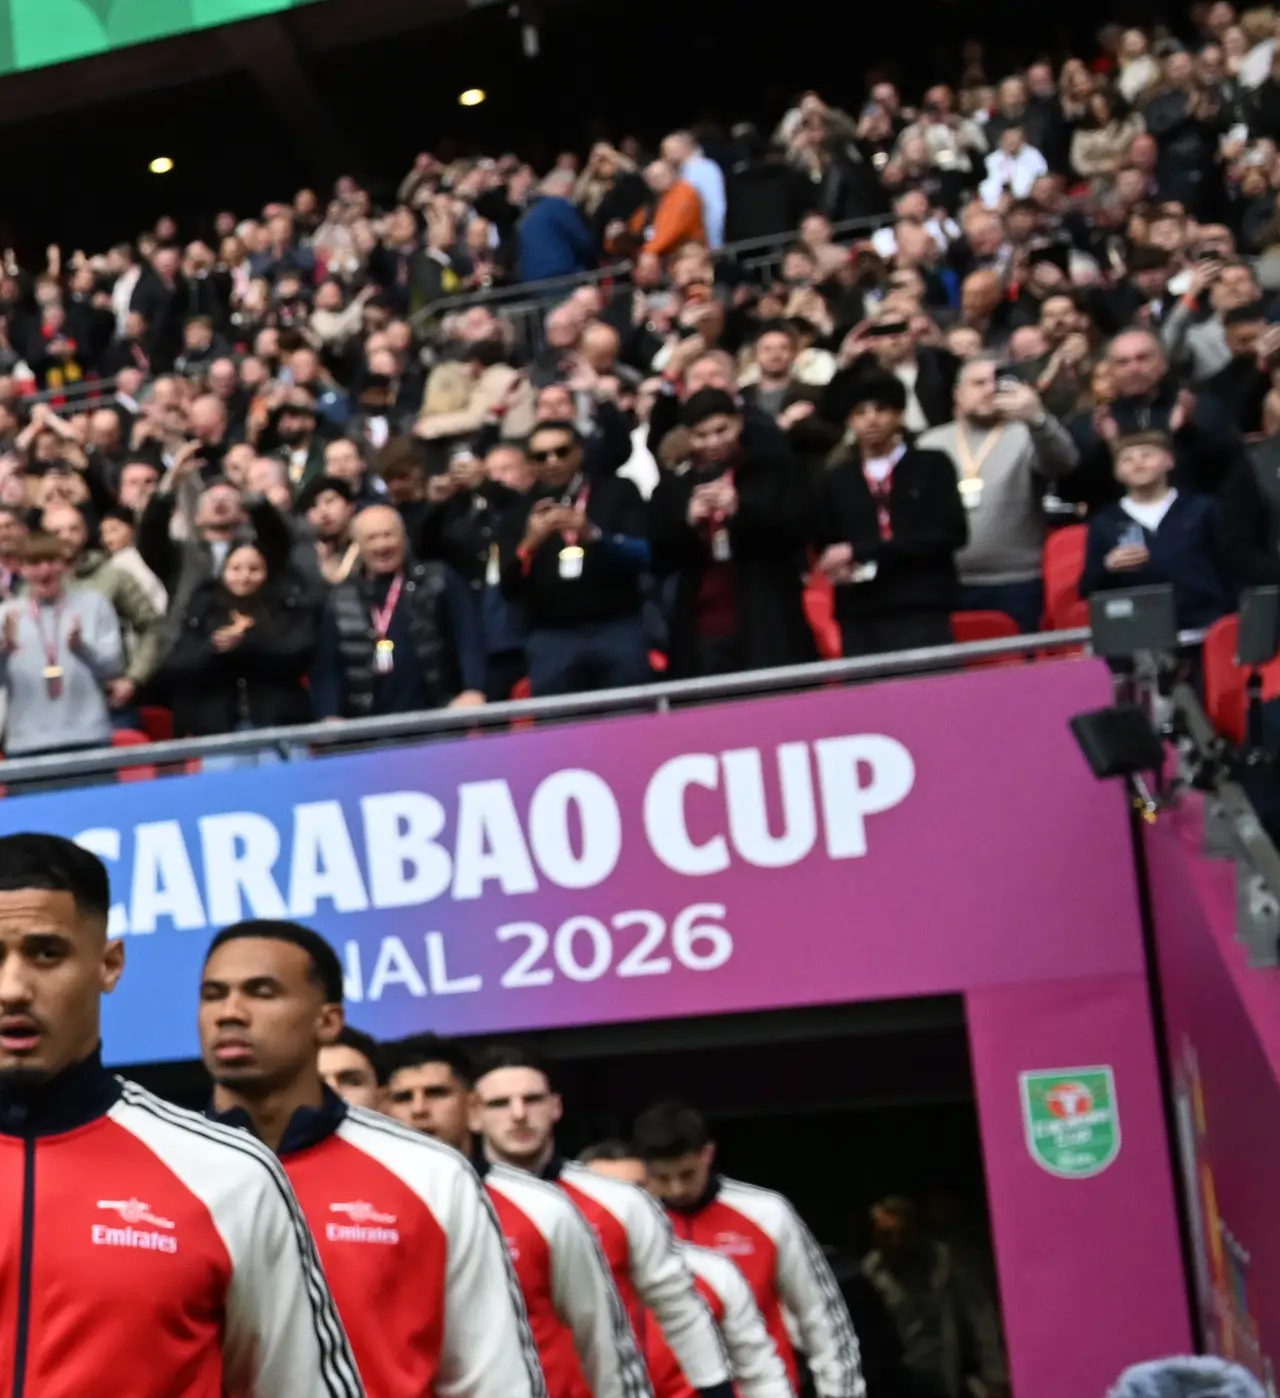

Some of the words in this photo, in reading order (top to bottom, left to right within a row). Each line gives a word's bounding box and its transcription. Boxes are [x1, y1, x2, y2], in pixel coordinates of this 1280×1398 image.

[644, 734, 915, 876] CUP
[496, 903, 734, 989] 2026
[91, 1223, 178, 1254] Emirates
